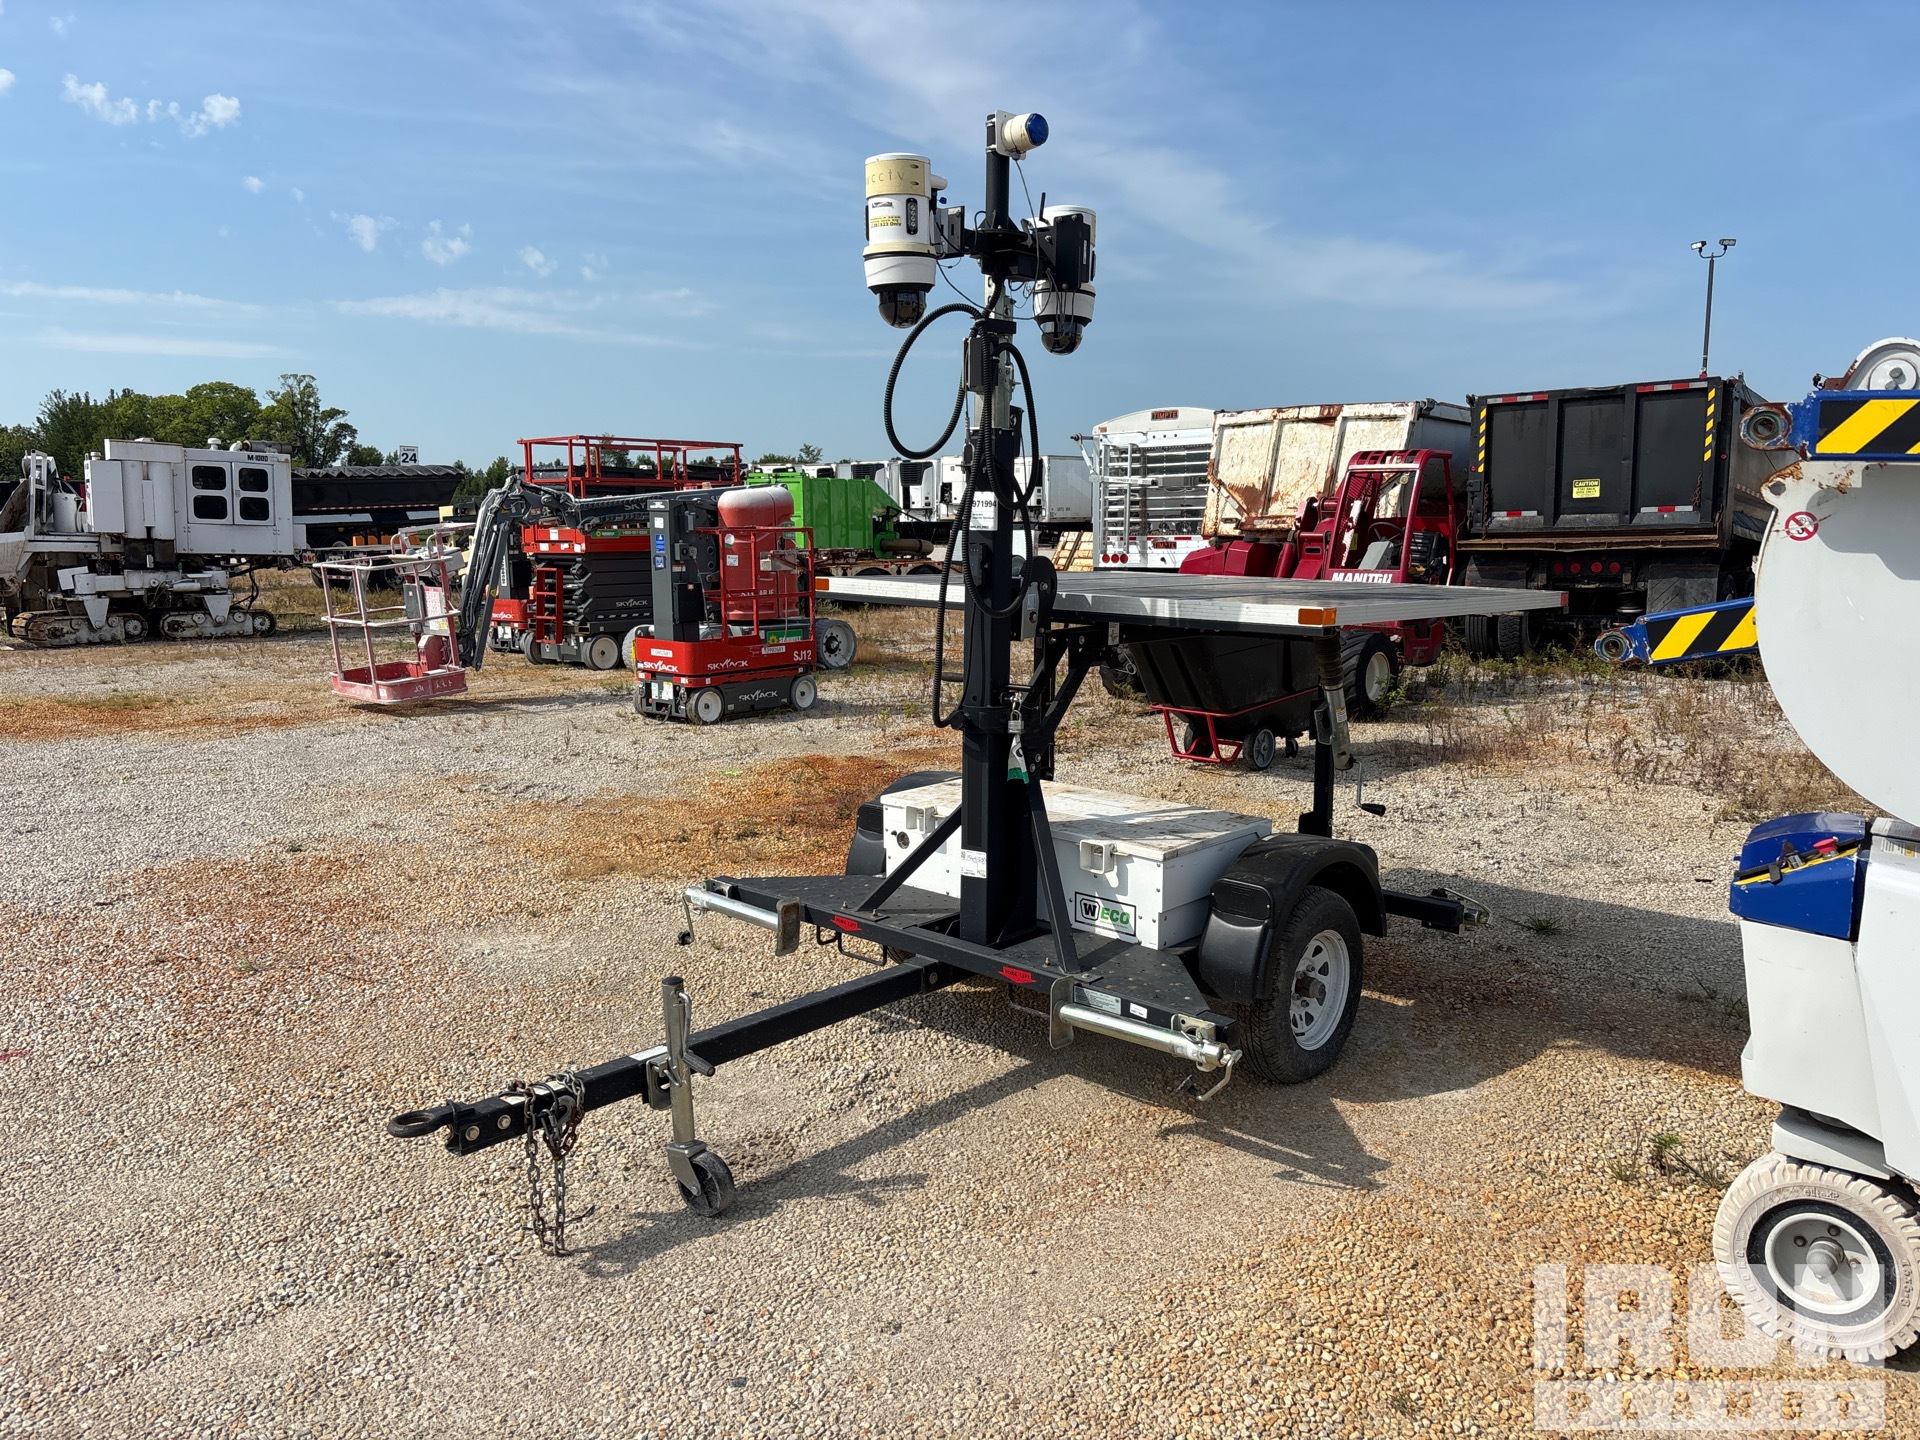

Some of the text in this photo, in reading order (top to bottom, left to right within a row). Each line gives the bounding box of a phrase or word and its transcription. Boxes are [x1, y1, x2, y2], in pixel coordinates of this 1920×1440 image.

[1152, 410, 1178, 419] TIMPTE
[247, 454, 269, 462] M-1000
[401, 452, 418, 464] 24
[1153, 541, 1176, 549] TIMPTE
[615, 598, 648, 608] SKYJACK
[492, 611, 513, 619] SKYJACK
[793, 650, 812, 662] SJ12
[643, 660, 679, 673] SKYJACK
[738, 689, 778, 701] SKYJACK
